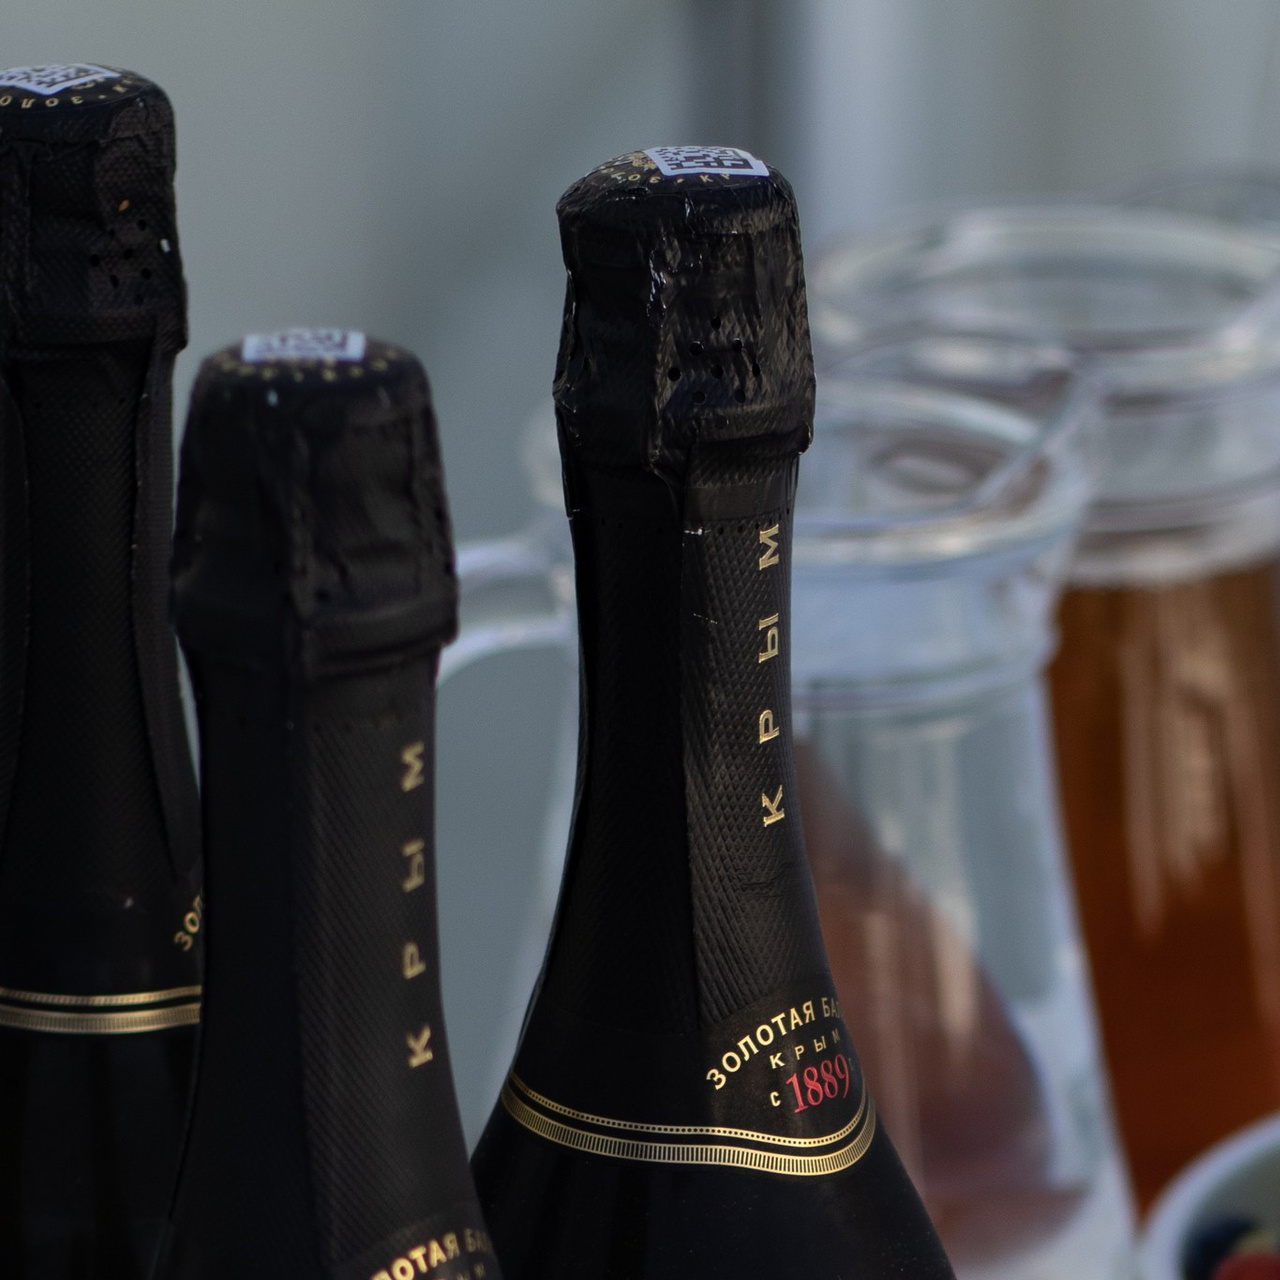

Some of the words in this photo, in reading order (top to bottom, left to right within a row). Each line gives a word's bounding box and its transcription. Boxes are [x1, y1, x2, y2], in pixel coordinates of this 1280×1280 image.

[758, 523, 786, 828] КРЫМ
[706, 1000, 816, 1091] ЗОЛОТАЯ
[769, 1028, 841, 1070] КРЫМ
[786, 1053, 850, 1114] 1889
